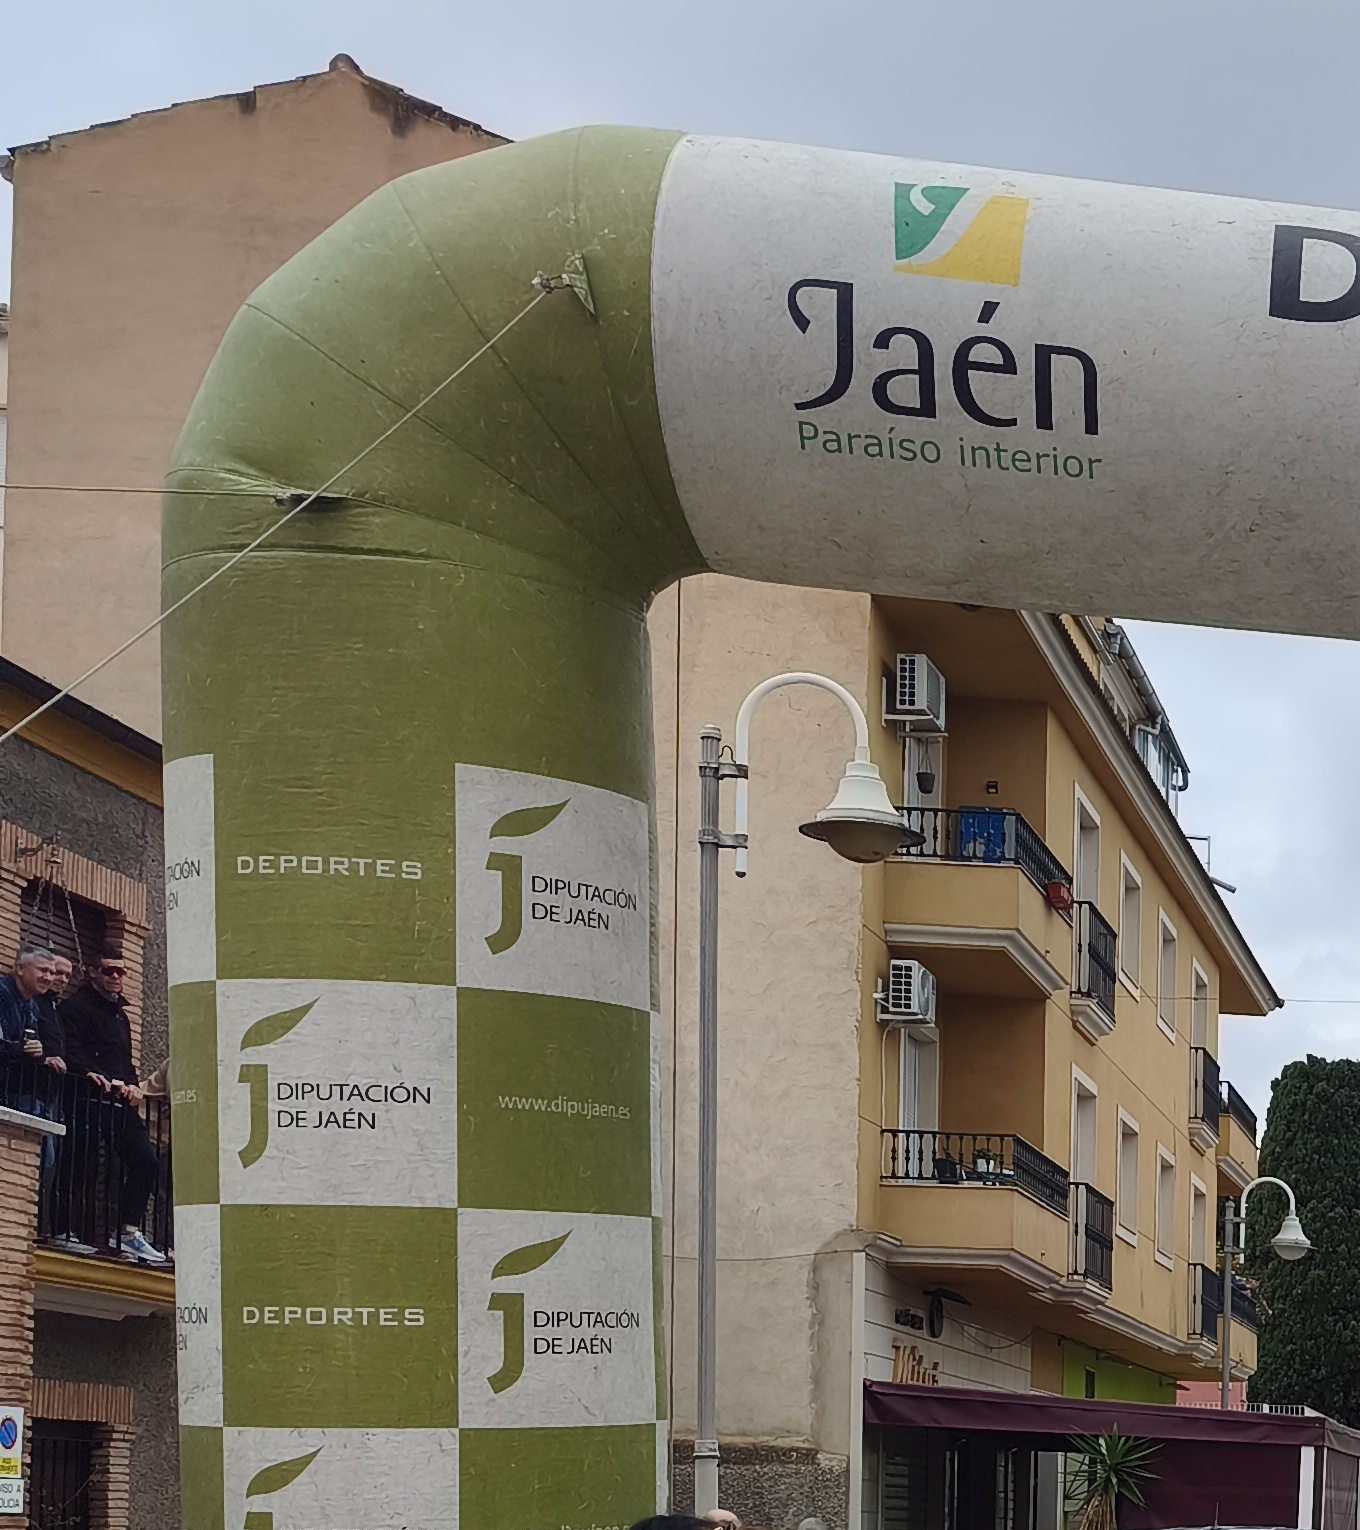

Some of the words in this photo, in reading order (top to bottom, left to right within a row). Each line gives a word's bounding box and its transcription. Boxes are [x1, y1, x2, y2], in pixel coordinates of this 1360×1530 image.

[786, 277, 1102, 436] Jaén
[798, 421, 940, 463] Paraíso
[959, 438, 1102, 479] interior
[238, 856, 421, 879] DEPORTES
[532, 876, 637, 911] DIPUTACIÓN
[532, 903, 560, 922] DE
[564, 908, 609, 930] JAÉN
[278, 1082, 430, 1104] DIPUTACIÓN
[278, 1111, 307, 1127] DE
[313, 1108, 375, 1129] JAÉN
[499, 1096, 630, 1119] www.dipujaen.es
[244, 1307, 424, 1325] DEPORTES
[534, 1309, 639, 1328] DIPUTACIÓN
[534, 1338, 562, 1354] DE
[567, 1334, 611, 1354] JAÉN
